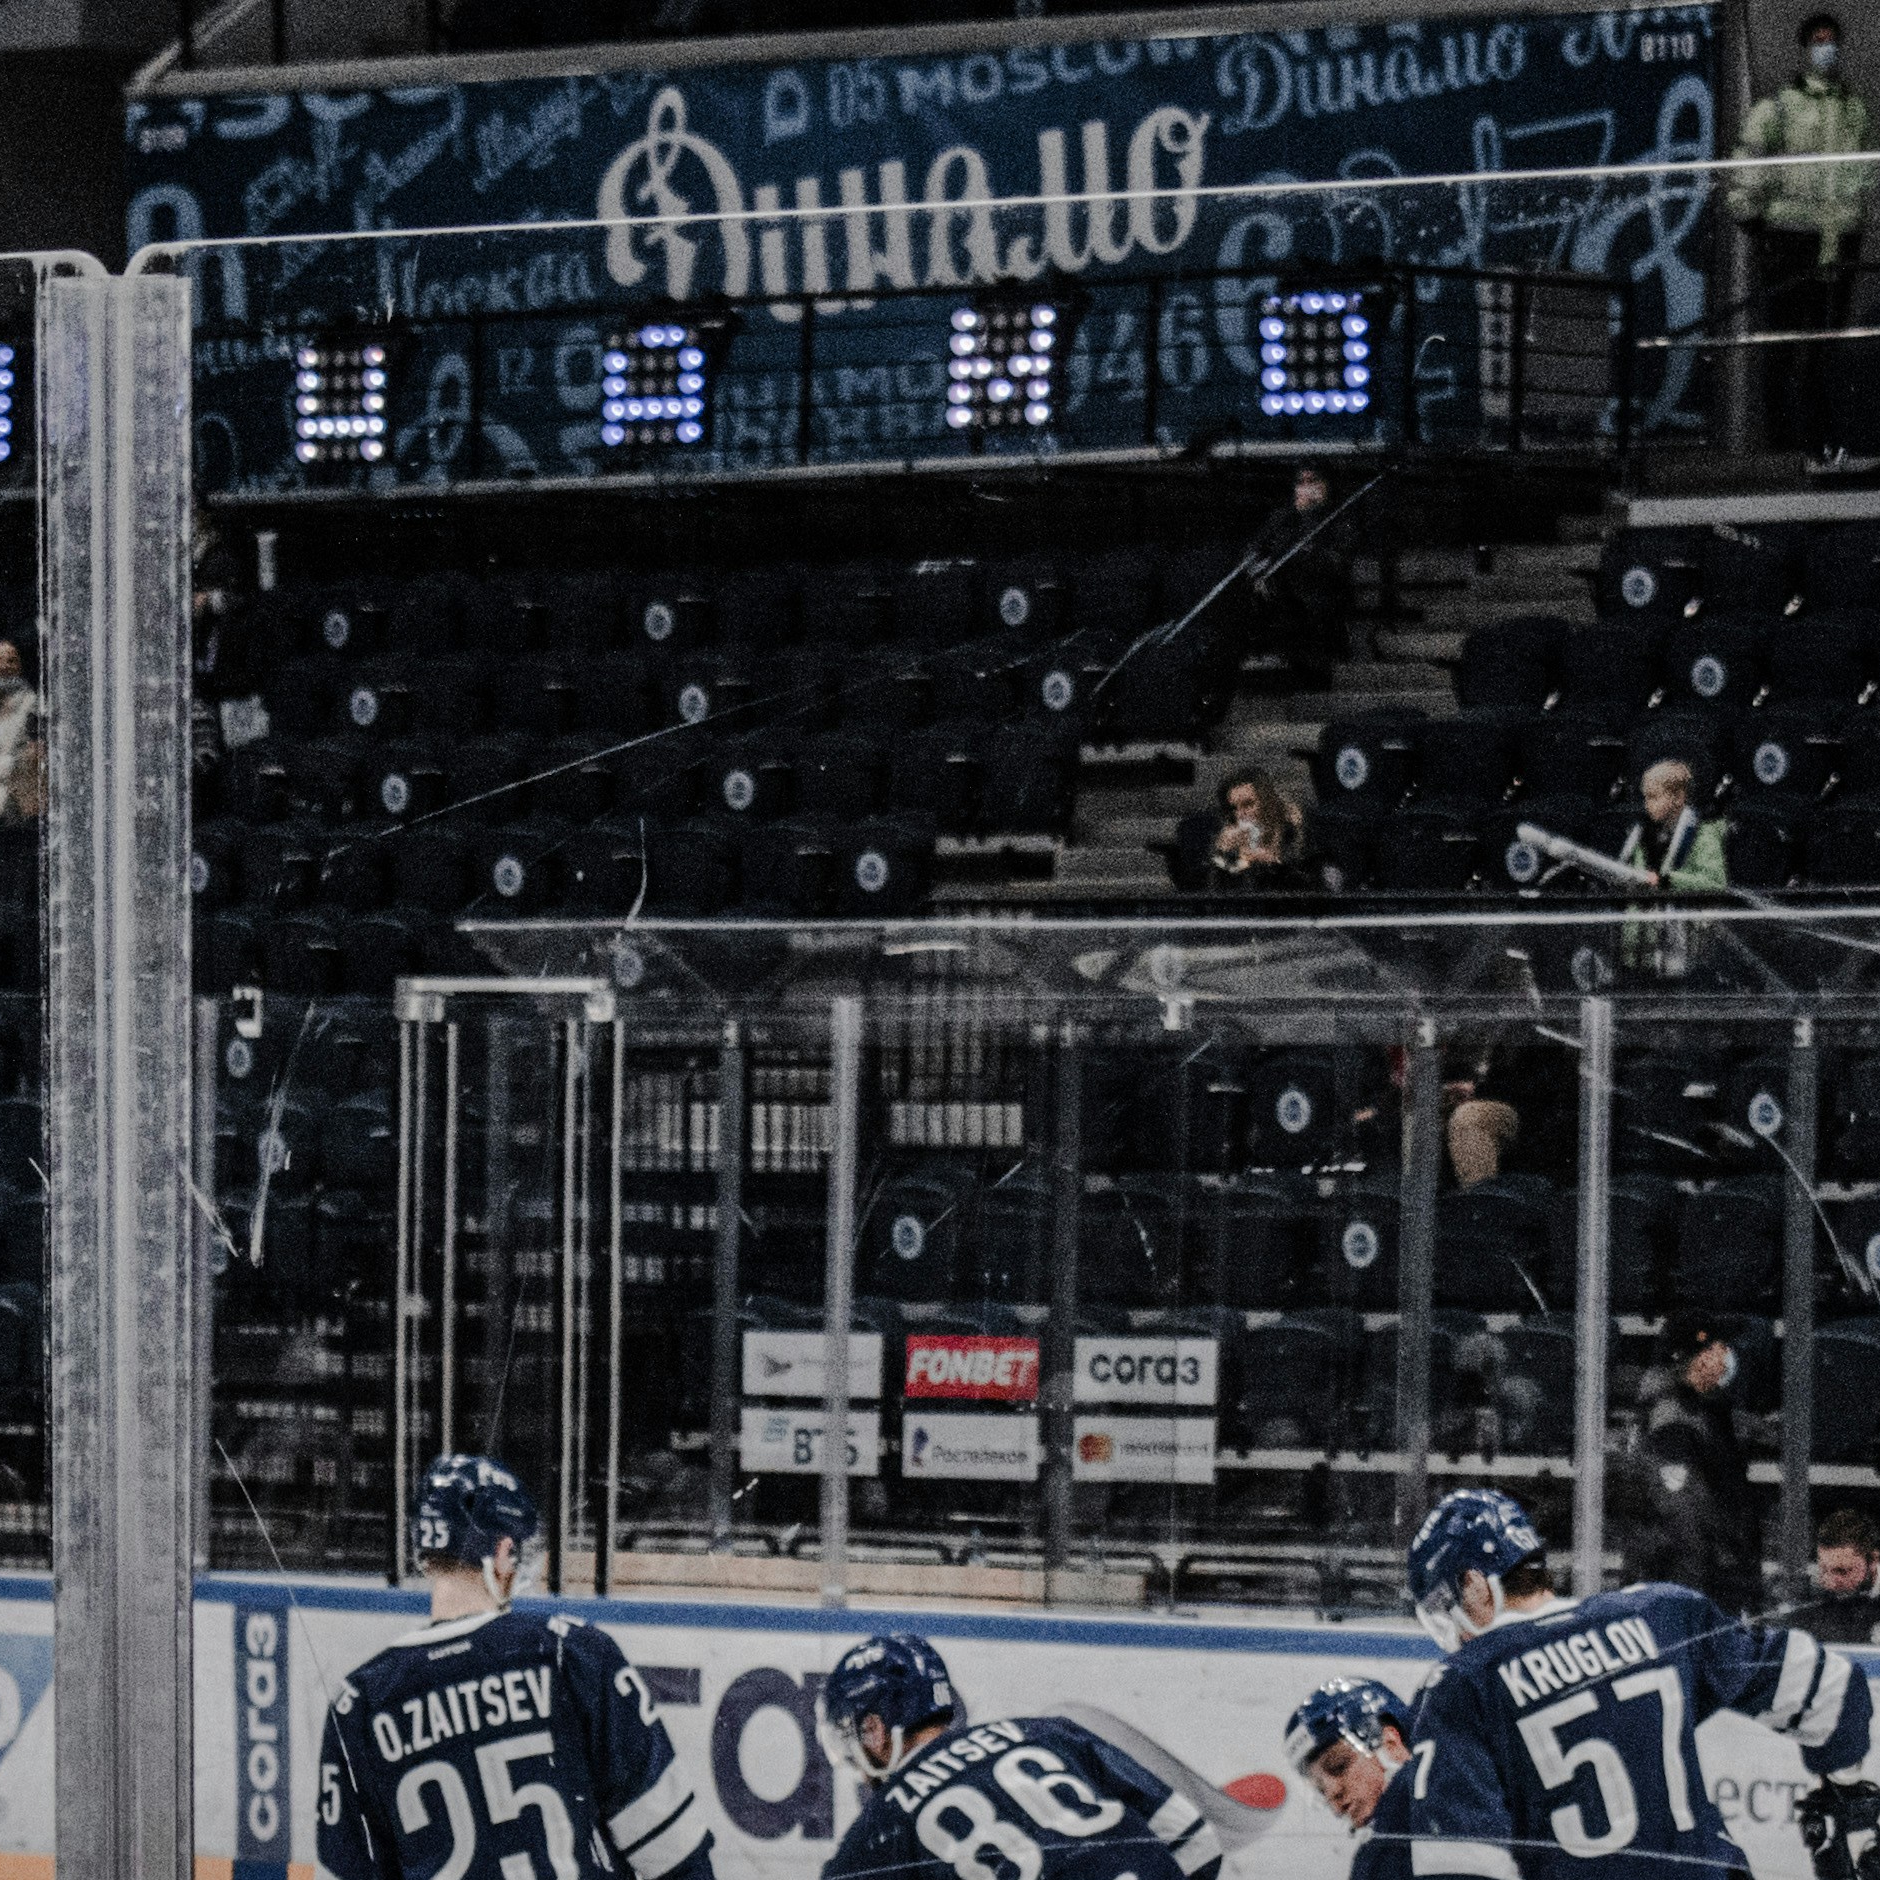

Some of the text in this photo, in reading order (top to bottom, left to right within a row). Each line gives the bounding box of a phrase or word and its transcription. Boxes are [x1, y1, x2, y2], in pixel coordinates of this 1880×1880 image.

[1219, 24, 1527, 136] Динамо
[597, 85, 1214, 322] Динамо
[908, 1349, 1036, 1387] FONBET
[793, 1428, 859, 1467] ВБ
[420, 1520, 450, 1549] 25
[1498, 1617, 1660, 1708] KRUGLOV
[373, 1665, 553, 1763] O.ZAITSEV
[885, 1721, 1027, 1814] ZAITSEV
[1516, 1665, 1695, 1859] 57
